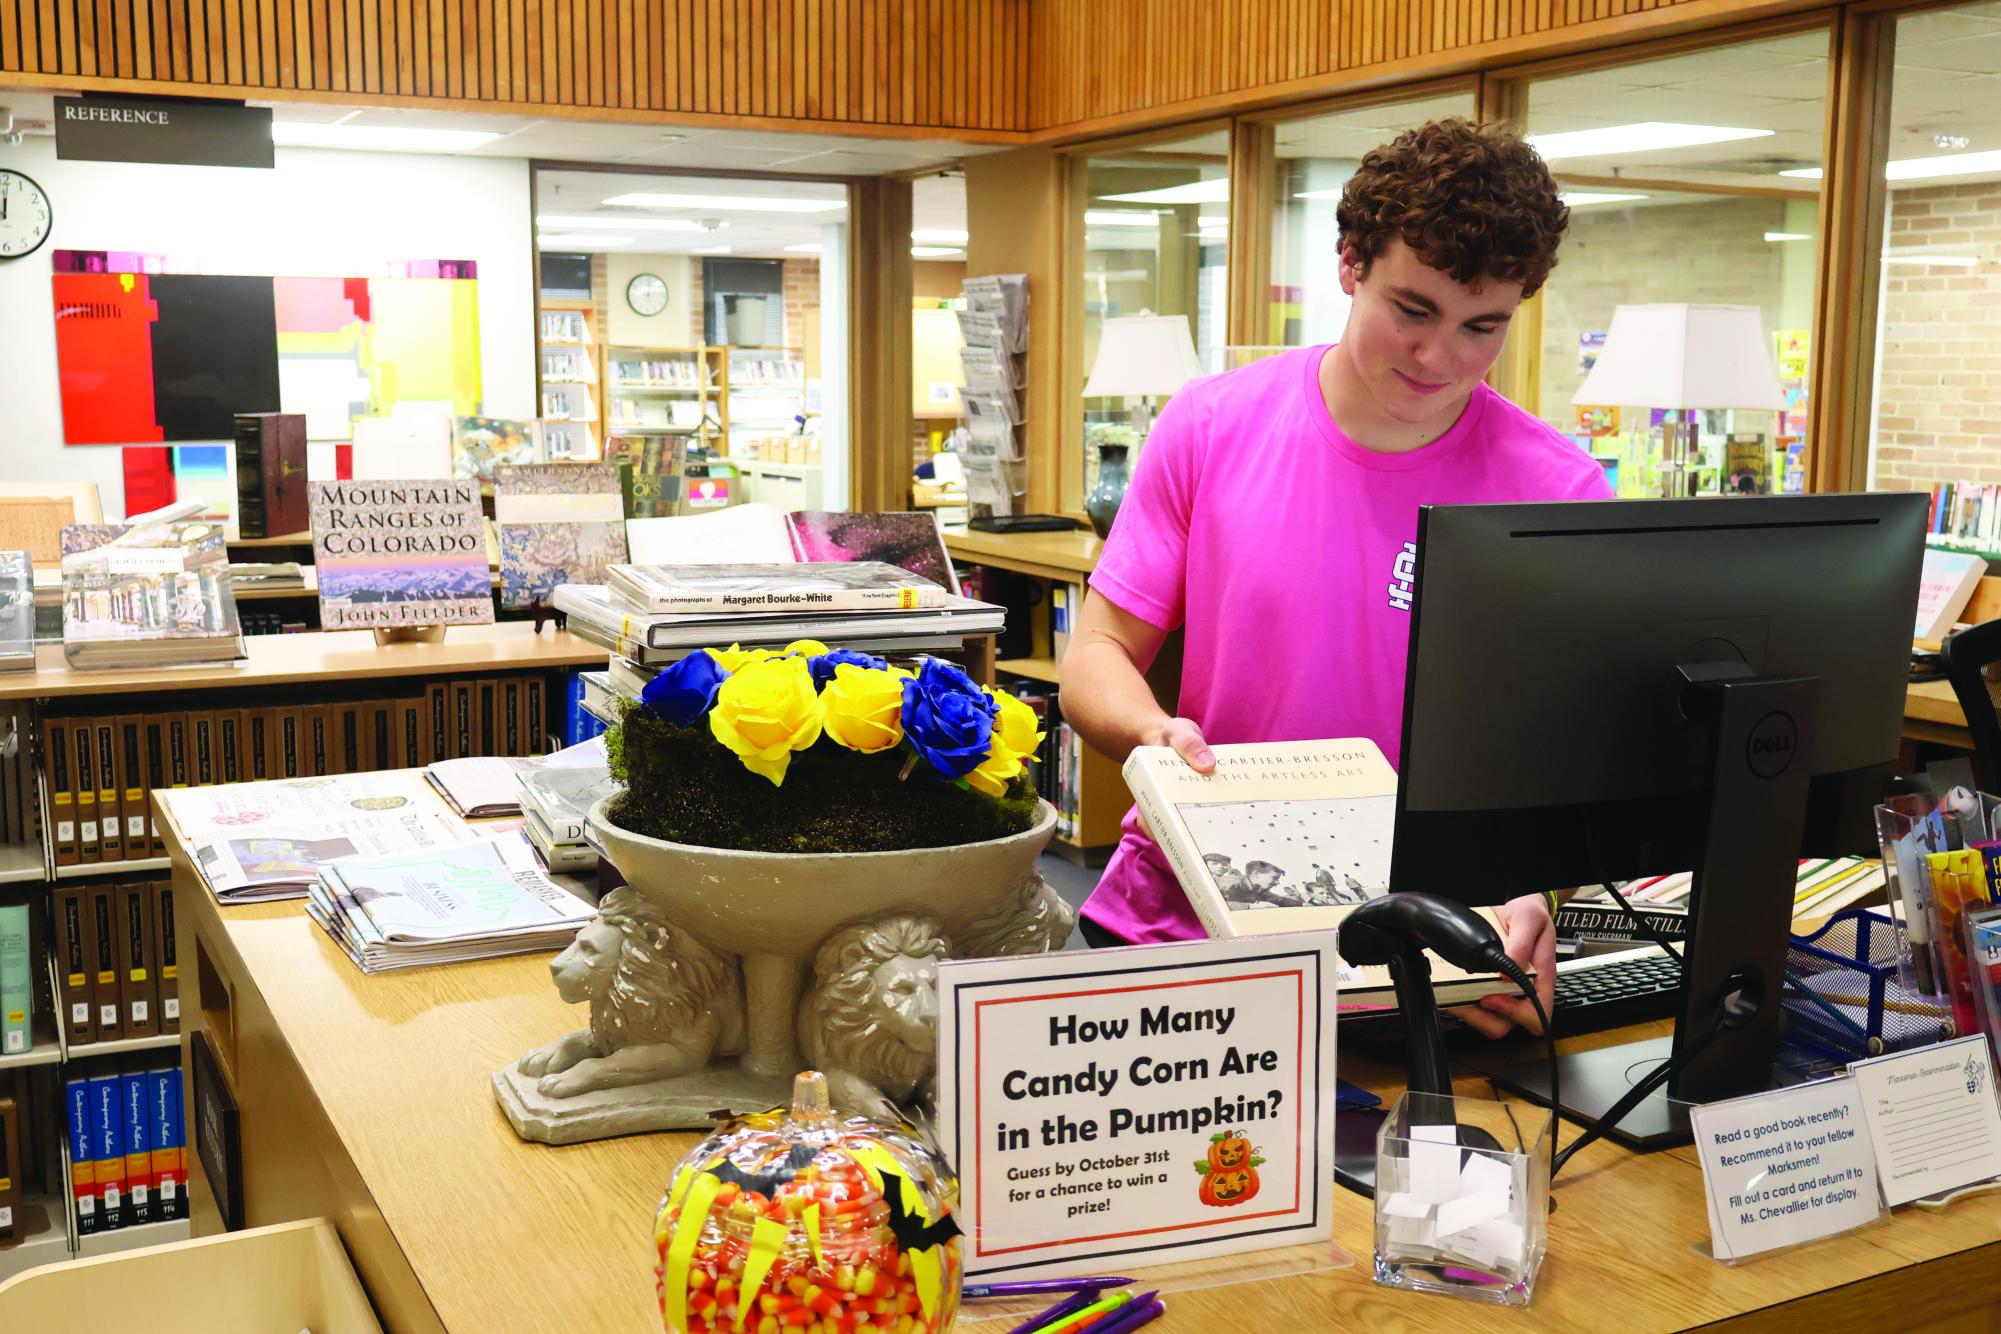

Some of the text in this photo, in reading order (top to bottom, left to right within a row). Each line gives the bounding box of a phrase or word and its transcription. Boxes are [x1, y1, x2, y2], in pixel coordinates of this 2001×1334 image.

[65, 106, 169, 125] REFERENCE
[31, 193, 39, 205] 2
[38, 209, 45, 221] 3
[33, 226, 39, 236] 4
[3, 242, 11, 252] 6
[320, 485, 471, 506] MOUNTAIN
[329, 509, 465, 529] RANGES OF
[323, 532, 477, 554] COLORADO
[722, 594, 766, 607] Margaret
[338, 605, 479, 625] JOHN FIELDER
[1752, 735, 1793, 754] DELL
[1158, 758, 1191, 768] HEN
[1178, 768, 1365, 783] AND THE ARTLESS ART
[1139, 789, 1153, 808] HENRI
[1182, 867, 1194, 887] AND
[1191, 884, 1203, 904] THE
[1603, 913, 1638, 931] FILM
[1644, 916, 1687, 934] STILL
[1573, 931, 1633, 941] CINDY SHERMAN
[1049, 1005, 1236, 1047] How Many
[1002, 1046, 1278, 1101] Candy Corn Are
[101, 1086, 114, 1154] Contemporary Authors
[130, 1081, 142, 1149] Contemporary Authors
[158, 1078, 170, 1146] Contemporary Authors
[997, 1089, 1283, 1152] in the Pumpkin?
[74, 1090, 88, 1158] Contemporary Authors
[1714, 1105, 1849, 1145] Read a good book recently?
[1720, 1128, 1855, 1167] Recommend it to your fellow
[1007, 1149, 1171, 1181] Guess by October 31st
[1767, 1153, 1820, 1176] Marksmen!
[1008, 1172, 1168, 1203] for a chance to win a
[1729, 1167, 1863, 1208] Fill out a card and return it to
[108, 1213, 120, 1223] 112
[136, 1208, 148, 1218] 113
[162, 1204, 175, 1214] 114
[1067, 1198, 1111, 1218] prize!
[1740, 1212, 1757, 1225] Ms.
[1759, 1200, 1809, 1220] Chevallier
[1811, 1194, 1823, 1207] for
[83, 1218, 95, 1227] 111
